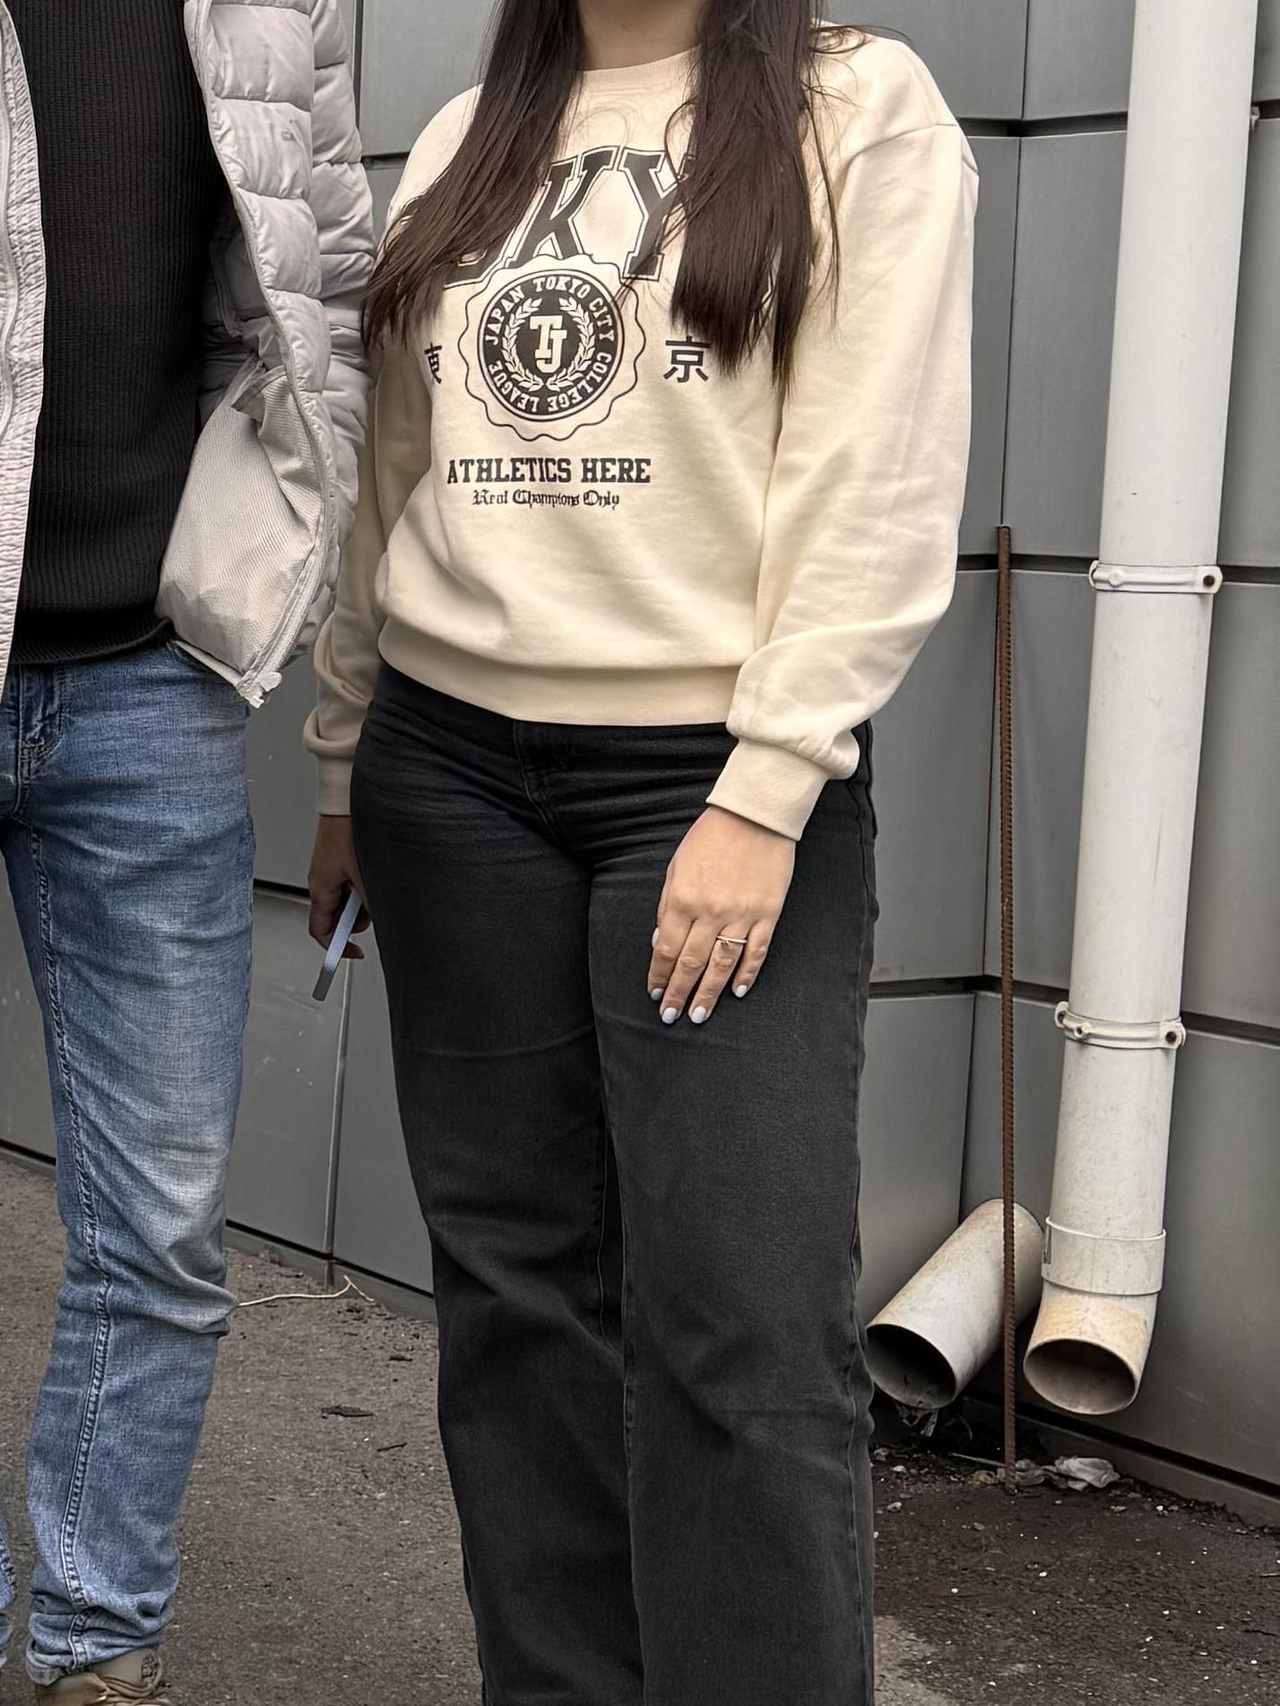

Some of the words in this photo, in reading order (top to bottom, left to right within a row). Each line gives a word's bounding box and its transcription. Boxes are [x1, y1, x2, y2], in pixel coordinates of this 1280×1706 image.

[532, 276, 591, 299] TOKYO
[485, 285, 525, 345] JAPAN
[588, 297, 615, 341] CITY
[529, 314, 568, 374] TJ
[663, 335, 710, 383] 京
[488, 360, 540, 412] LEAGUE
[547, 351, 612, 412] COLLEGE
[446, 457, 572, 484] ATHLETICS
[580, 457, 652, 483] HERE
[512, 488, 580, 509] Champions
[582, 489, 620, 511] Only
